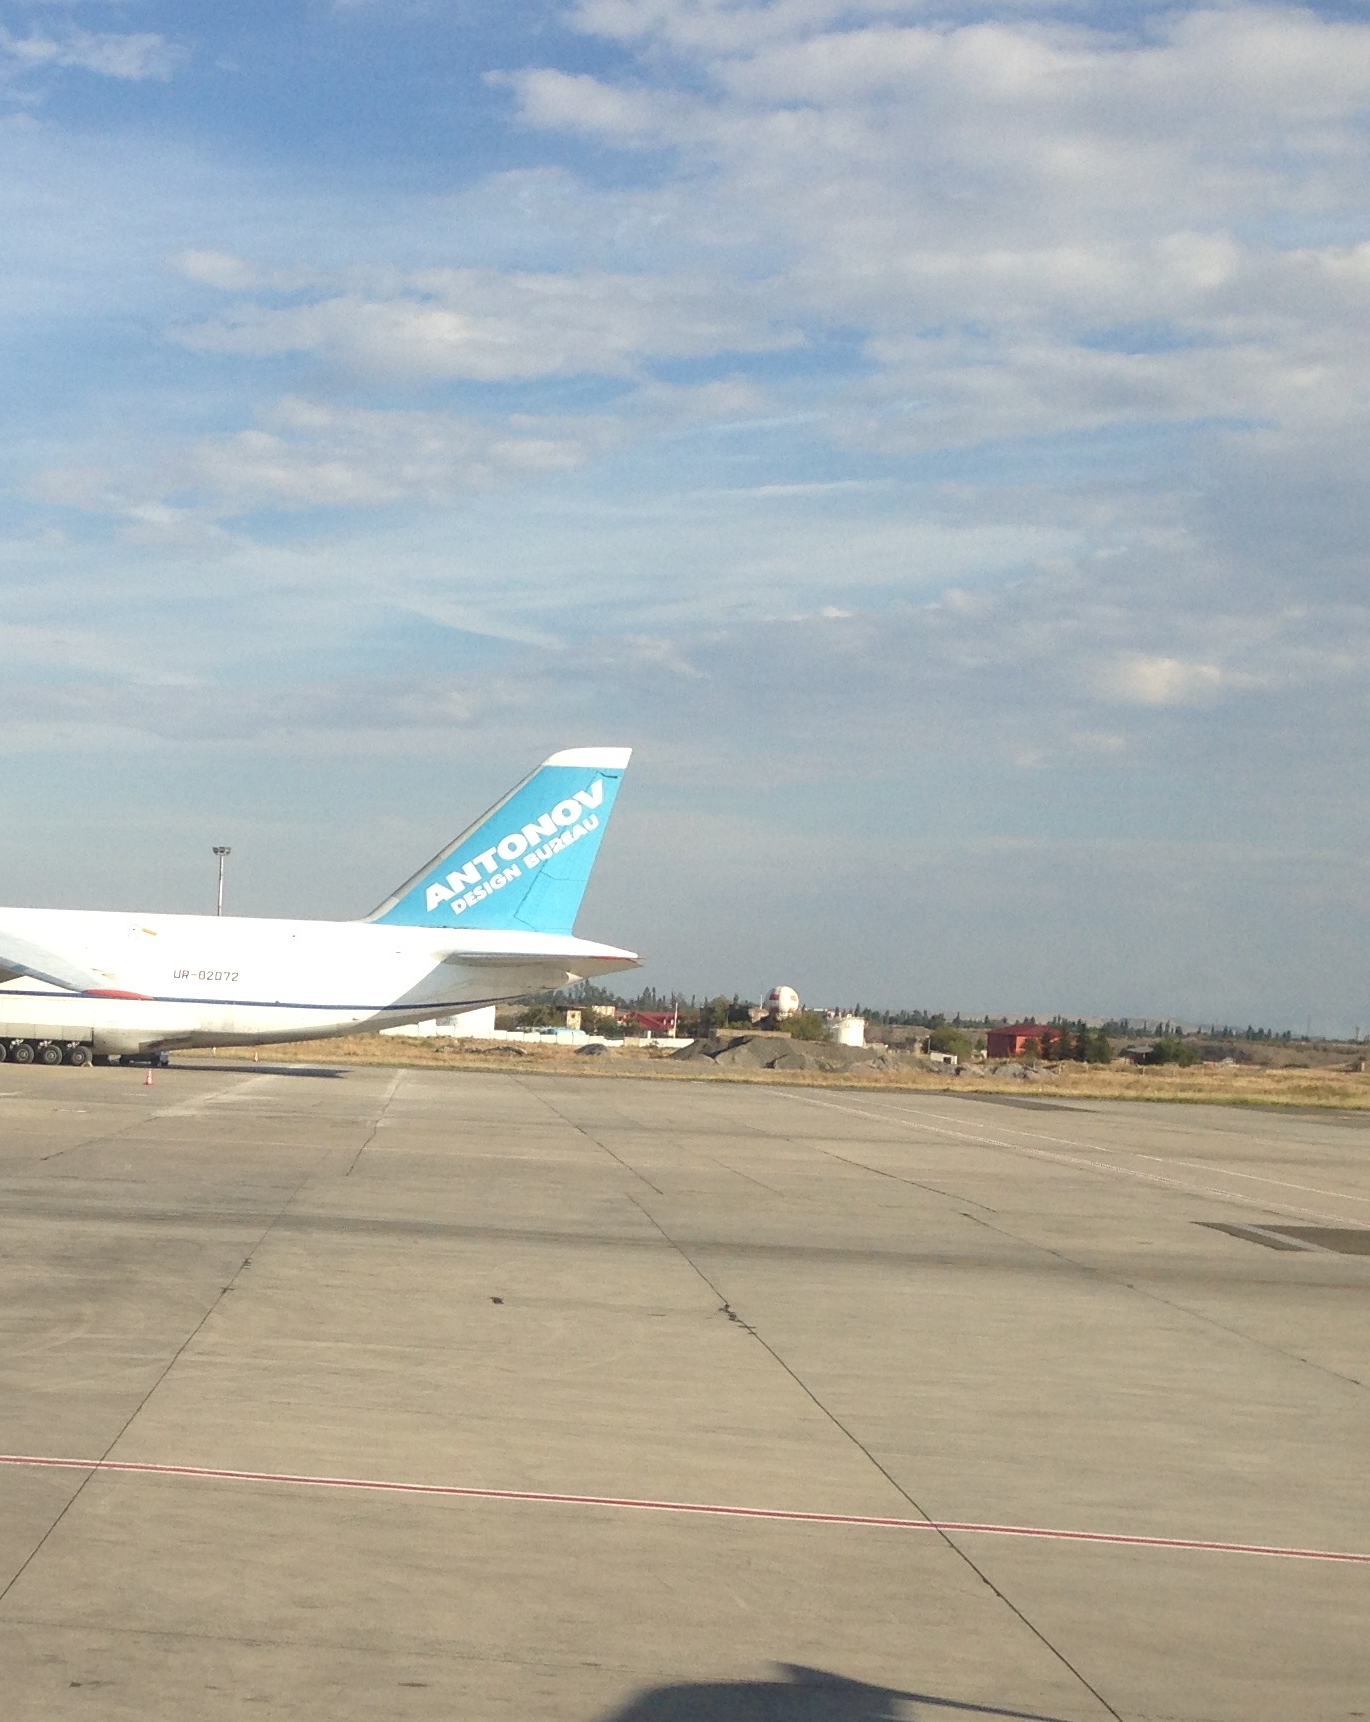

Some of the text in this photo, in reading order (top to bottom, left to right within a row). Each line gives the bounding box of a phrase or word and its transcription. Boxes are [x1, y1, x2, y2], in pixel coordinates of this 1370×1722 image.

[425, 778, 604, 913] ANTONOV
[450, 813, 600, 915] DESIGN BUREAU
[173, 969, 240, 982] UR-02072
